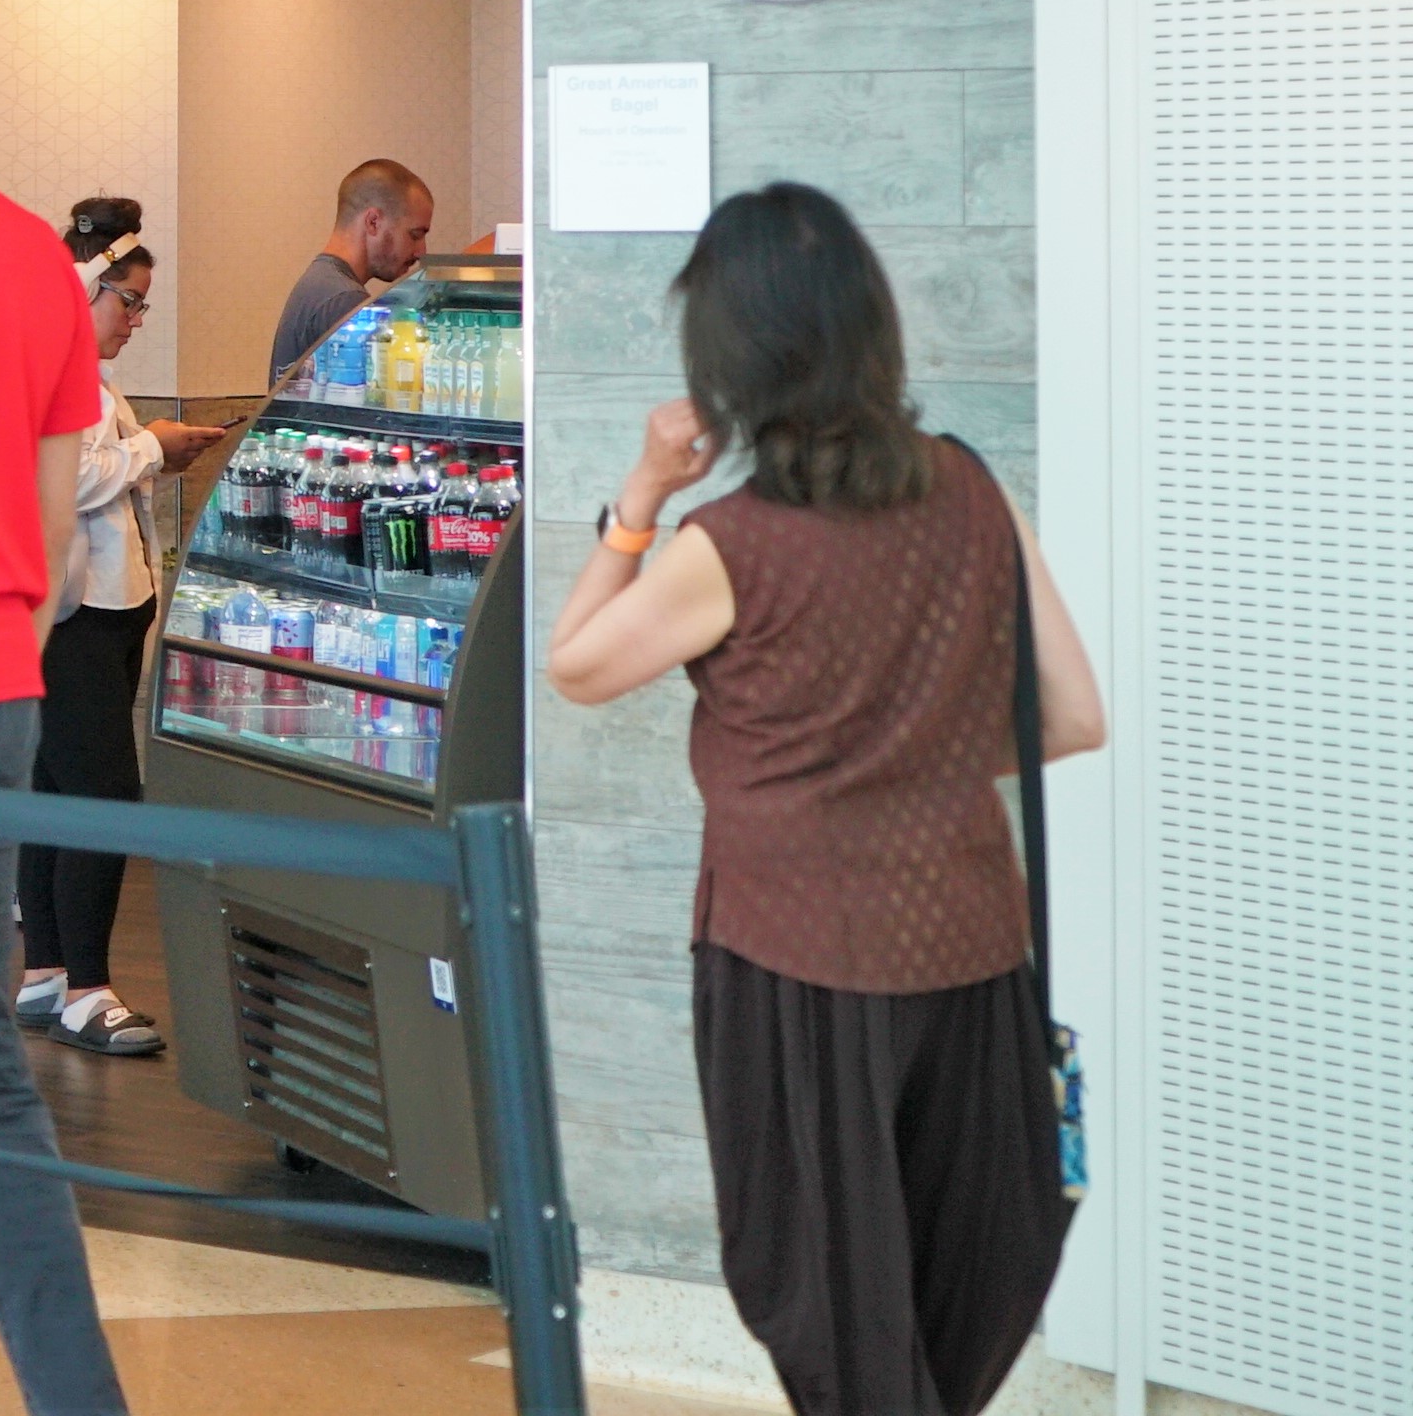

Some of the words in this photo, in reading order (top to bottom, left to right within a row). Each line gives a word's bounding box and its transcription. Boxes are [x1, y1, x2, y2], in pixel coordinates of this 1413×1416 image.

[566, 75, 612, 91] Great
[617, 75, 699, 90] American
[610, 96, 659, 116] Bagel
